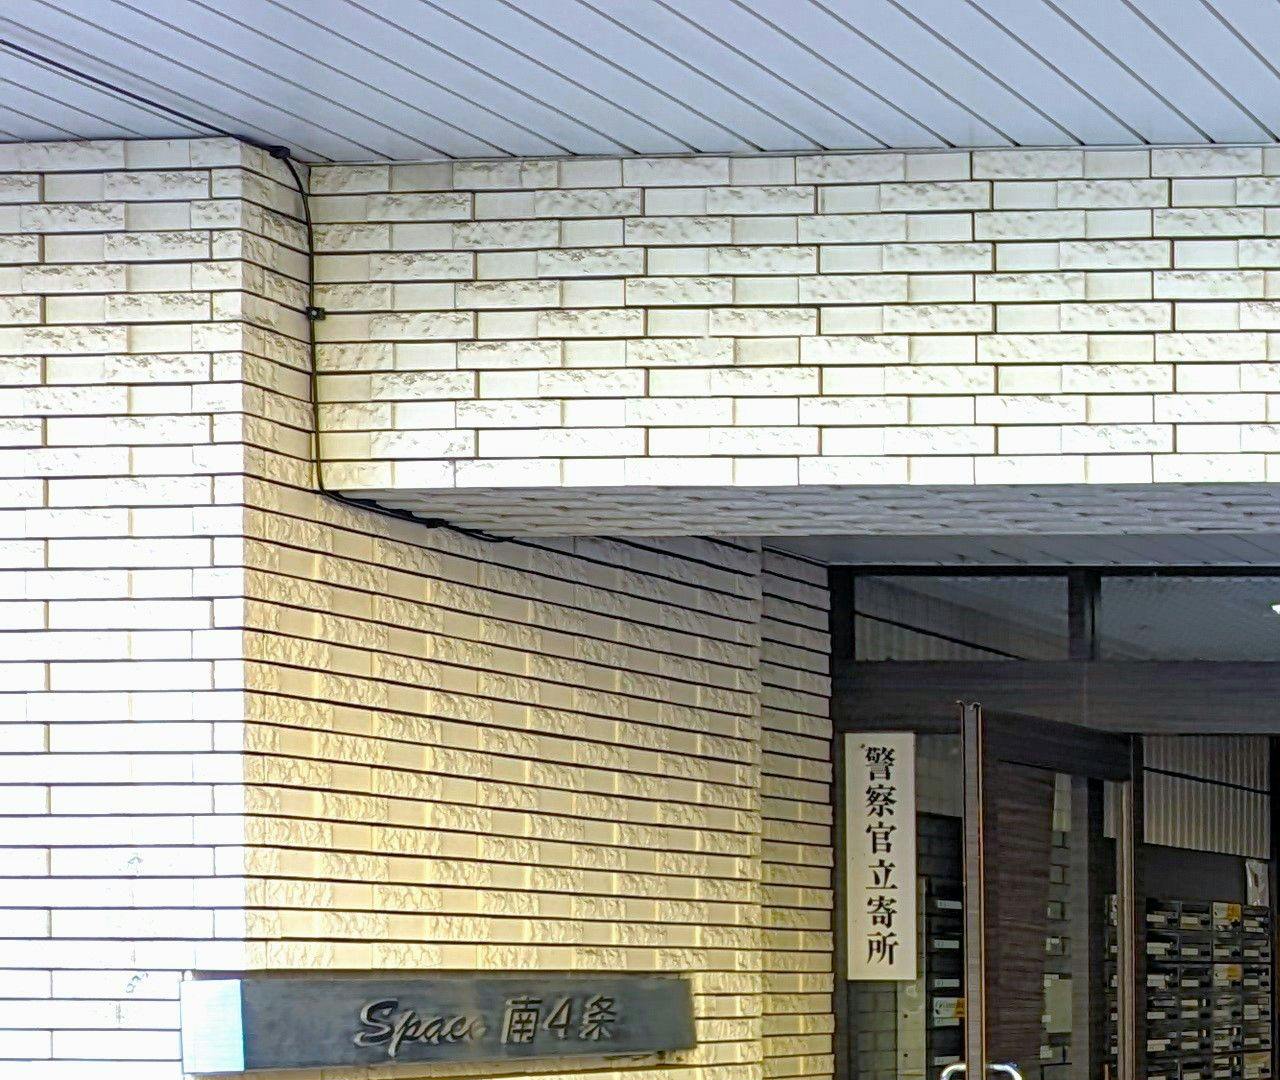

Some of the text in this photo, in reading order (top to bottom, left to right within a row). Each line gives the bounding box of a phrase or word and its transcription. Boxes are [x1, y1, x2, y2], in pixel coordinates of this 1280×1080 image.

[864, 744, 900, 966] 警察官立寄所
[354, 996, 617, 1062] Space 南4条
